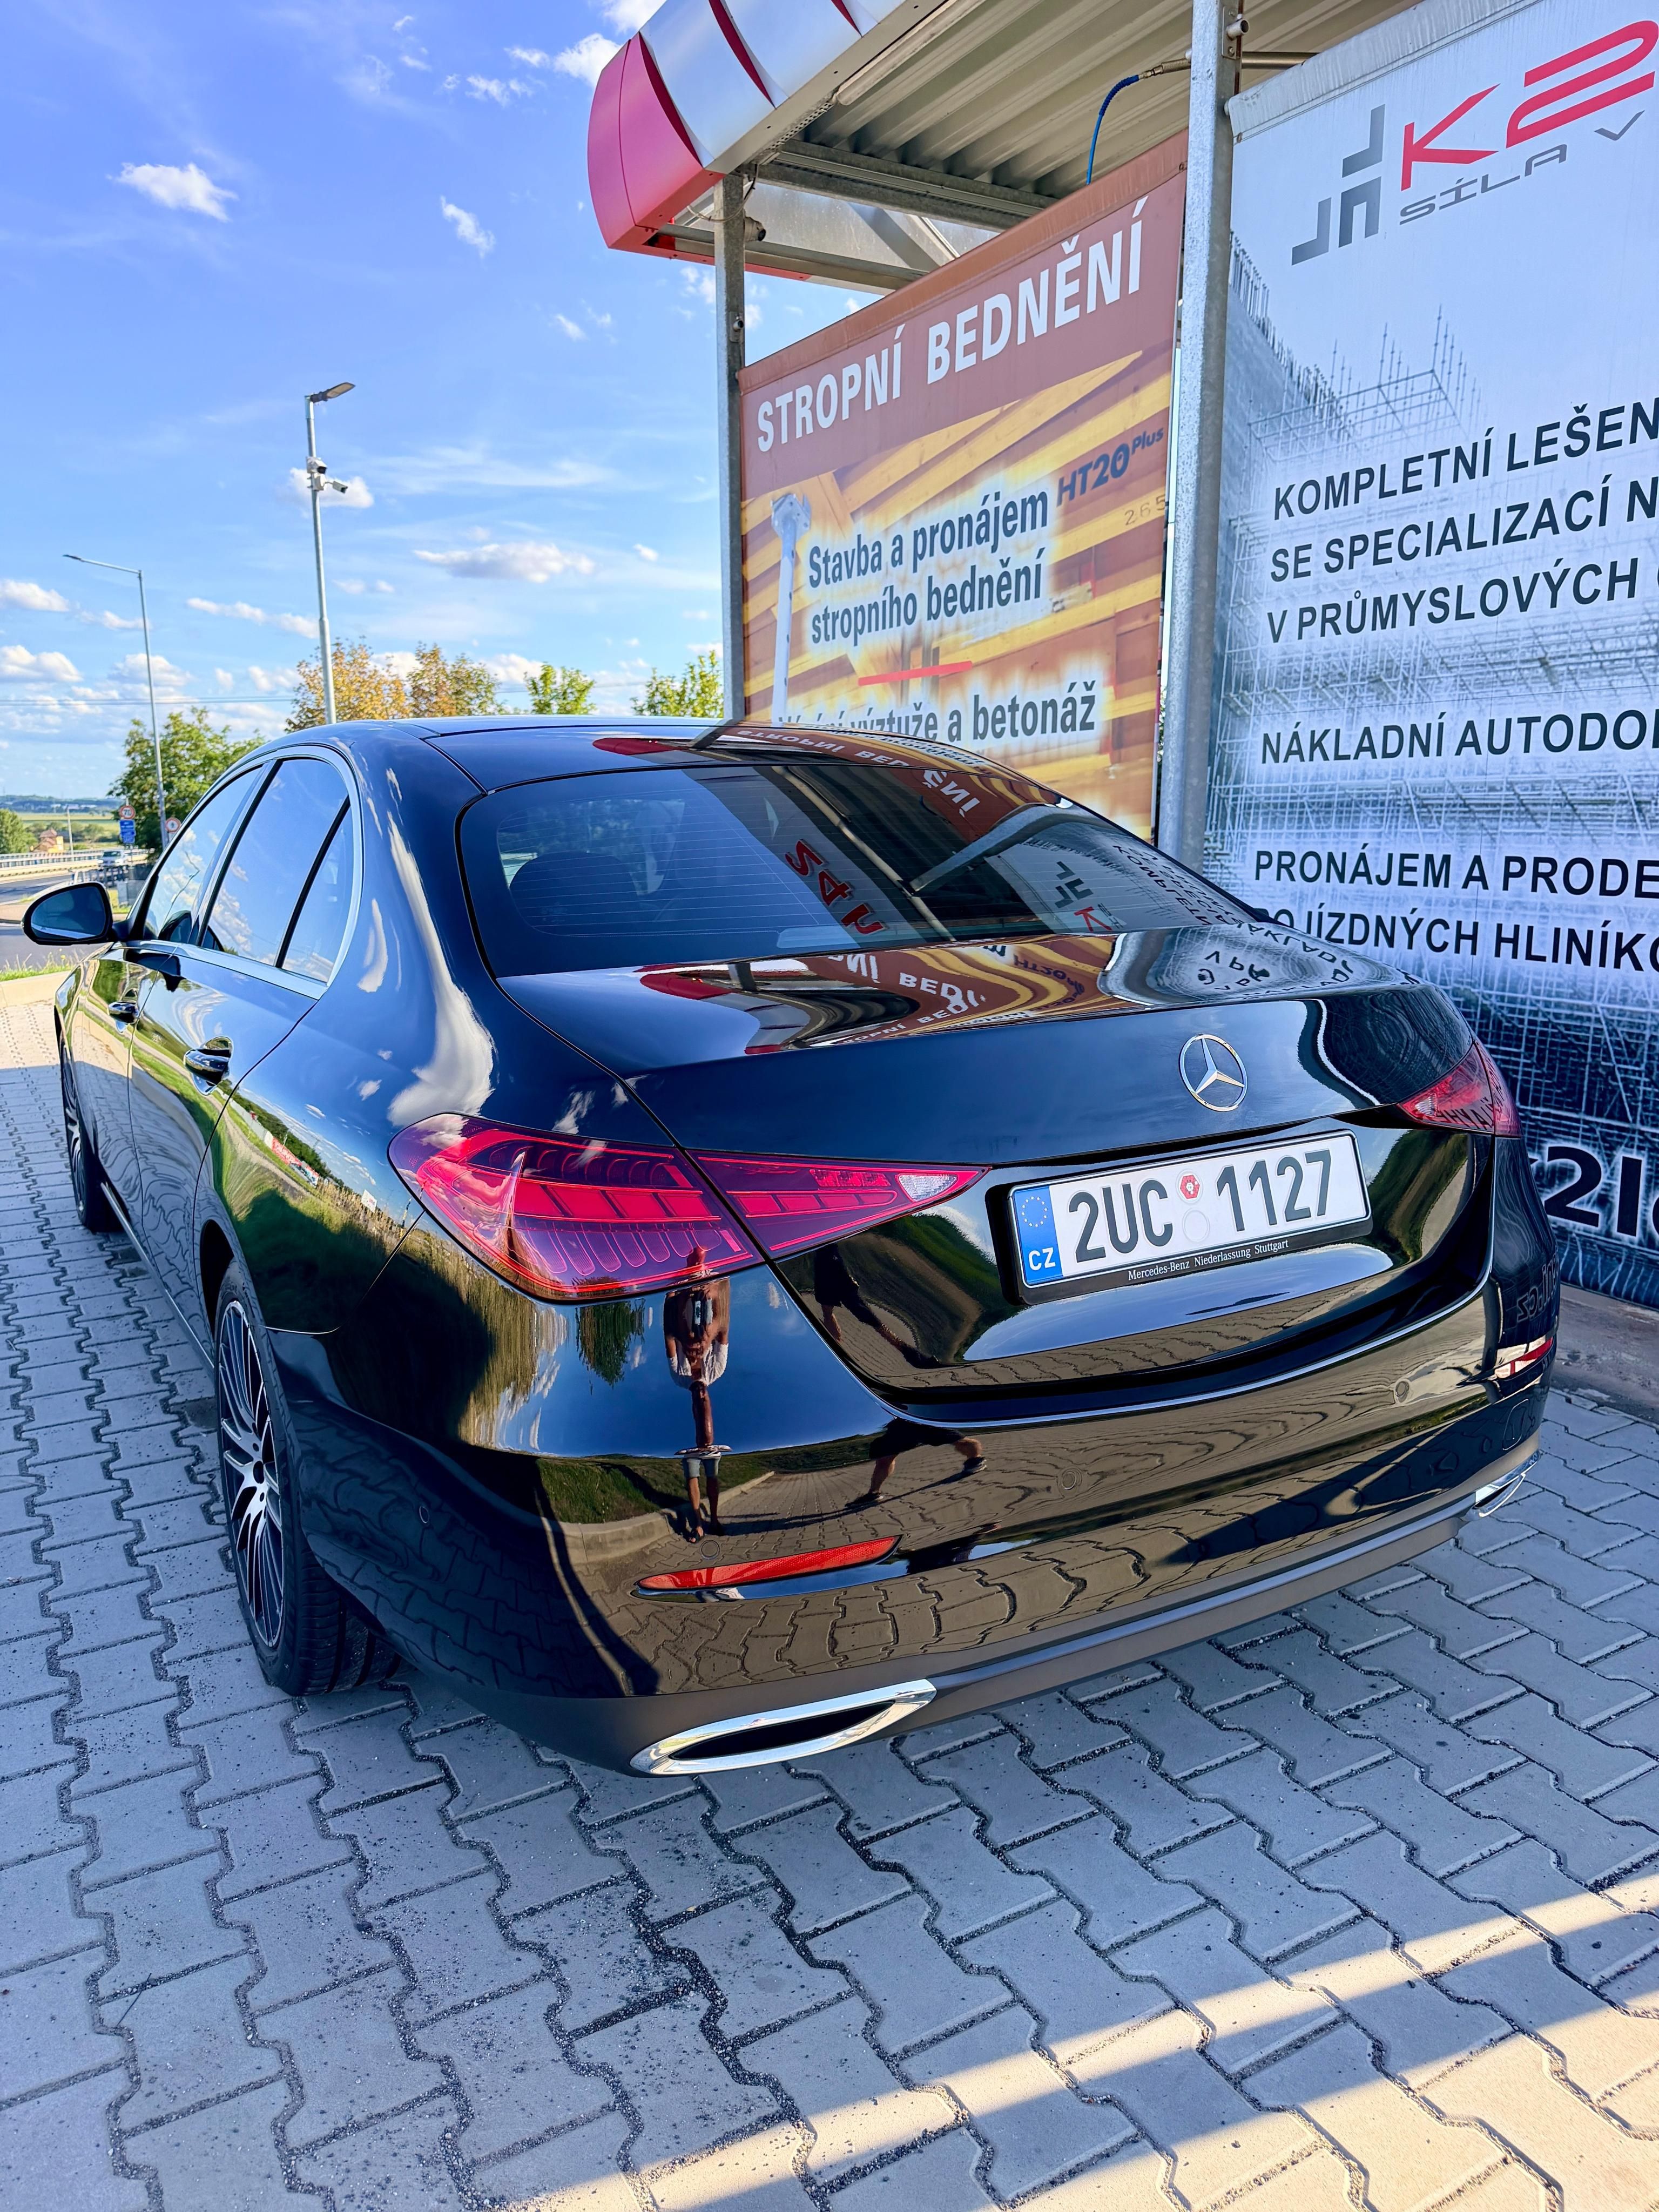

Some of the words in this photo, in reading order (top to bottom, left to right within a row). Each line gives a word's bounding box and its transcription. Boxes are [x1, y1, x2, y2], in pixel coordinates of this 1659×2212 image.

[1401, 20, 1659, 191] K2
[1400, 144, 1567, 225] SÍLA
[757, 324, 906, 453] STROPNÍ
[927, 195, 1149, 385] BEDNĚNÍ
[1274, 427, 1494, 521] KOMPLETNÍ
[1507, 397, 1659, 473] LEŠEN
[808, 533, 884, 588] Stavba
[891, 537, 903, 567] a
[913, 490, 1048, 574] pronájem
[1271, 543, 1312, 582] SE
[1324, 474, 1613, 574] SPECIALIZACÍ
[1627, 476, 1659, 522] N
[811, 585, 917, 647] stropního
[927, 547, 1046, 621] bednění
[1267, 610, 1288, 643] V
[1297, 557, 1638, 640] PRŮMYSLOVÝCH
[948, 709, 962, 743] a
[973, 680, 1096, 741] betonáž
[1261, 711, 1447, 764] NÁKLADNÍ
[1455, 709, 1659, 756] AUTODO
[1255, 843, 1451, 888] PRONÁJEM
[1462, 855, 1489, 891] A
[1502, 855, 1659, 899] PRODE
[1254, 902, 1479, 956] OJÍZDNÝCH
[1069, 1179, 1173, 1264] 2UC
[1216, 1149, 1332, 1232] 1127
[1027, 1249, 1056, 1272] CZ
[1128, 1259, 1190, 1282] Mercedes-Benz
[1194, 1247, 1252, 1267] Niederlassung
[1254, 1239, 1289, 1254] Stuttgart
